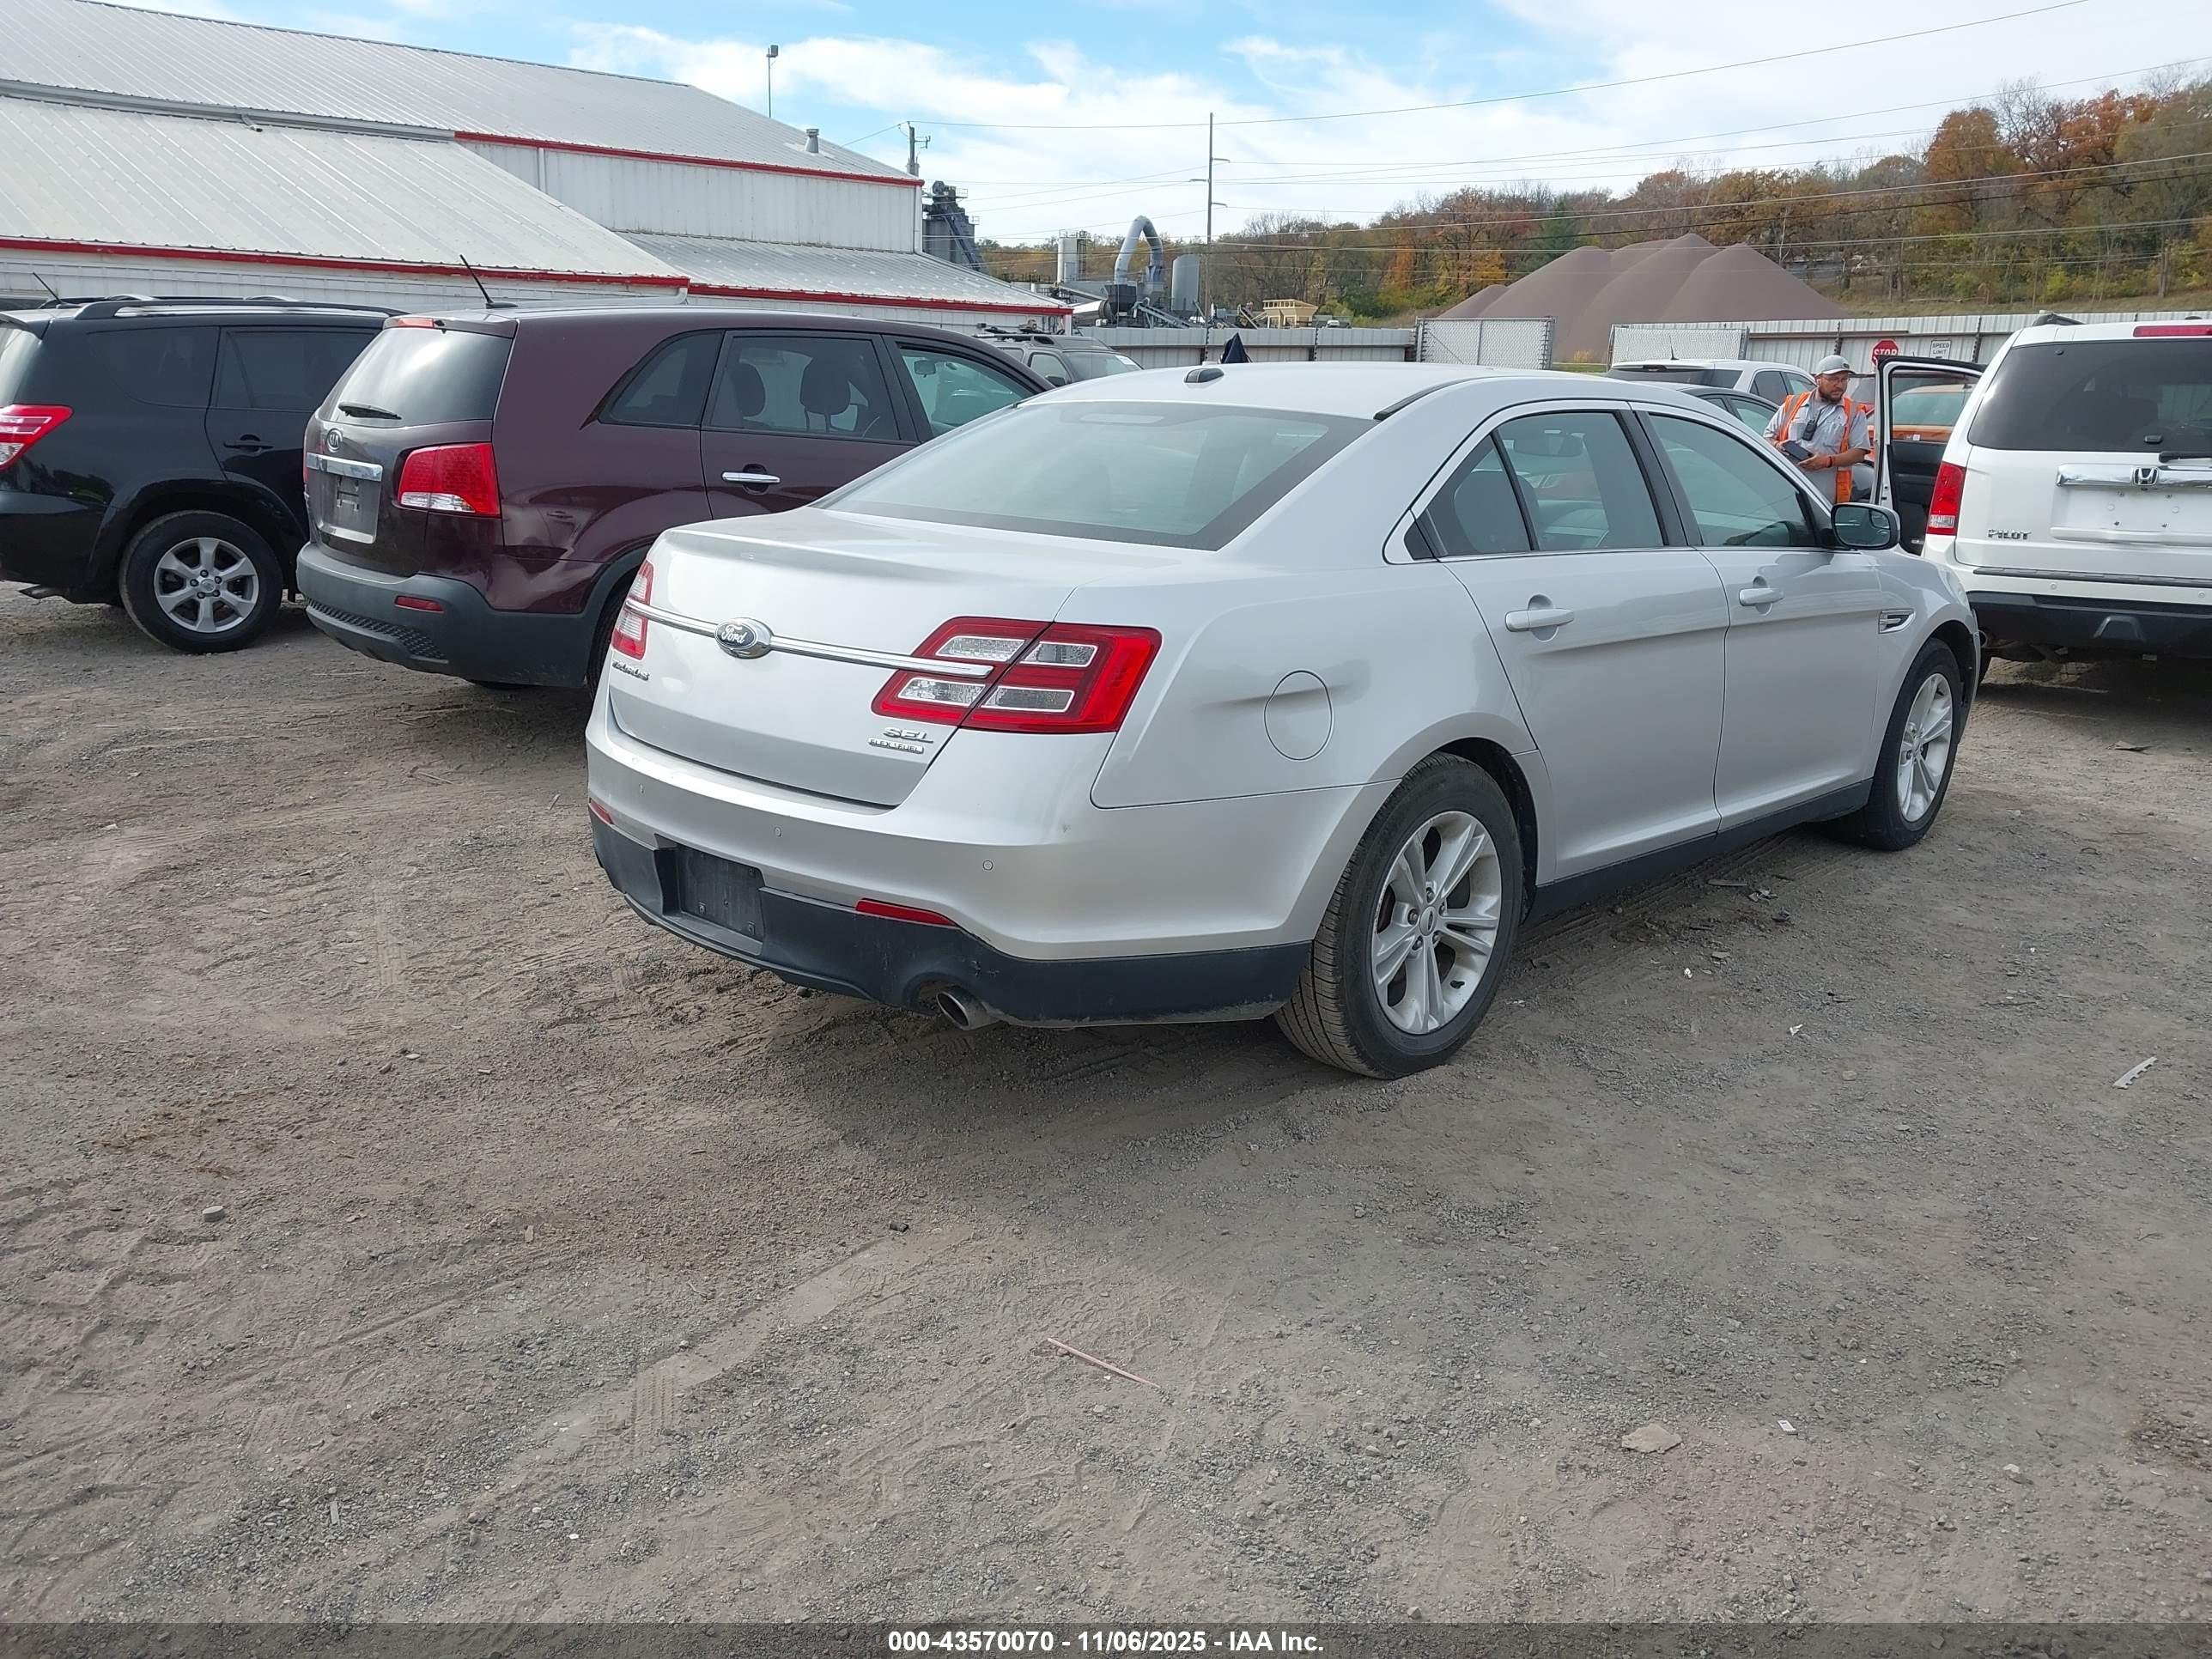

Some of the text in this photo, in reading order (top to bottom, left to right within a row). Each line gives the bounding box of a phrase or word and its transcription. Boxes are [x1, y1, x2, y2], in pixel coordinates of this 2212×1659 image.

[1988, 529, 2032, 540] PILOT
[720, 624, 747, 644] Ford
[883, 726, 933, 744] SEL
